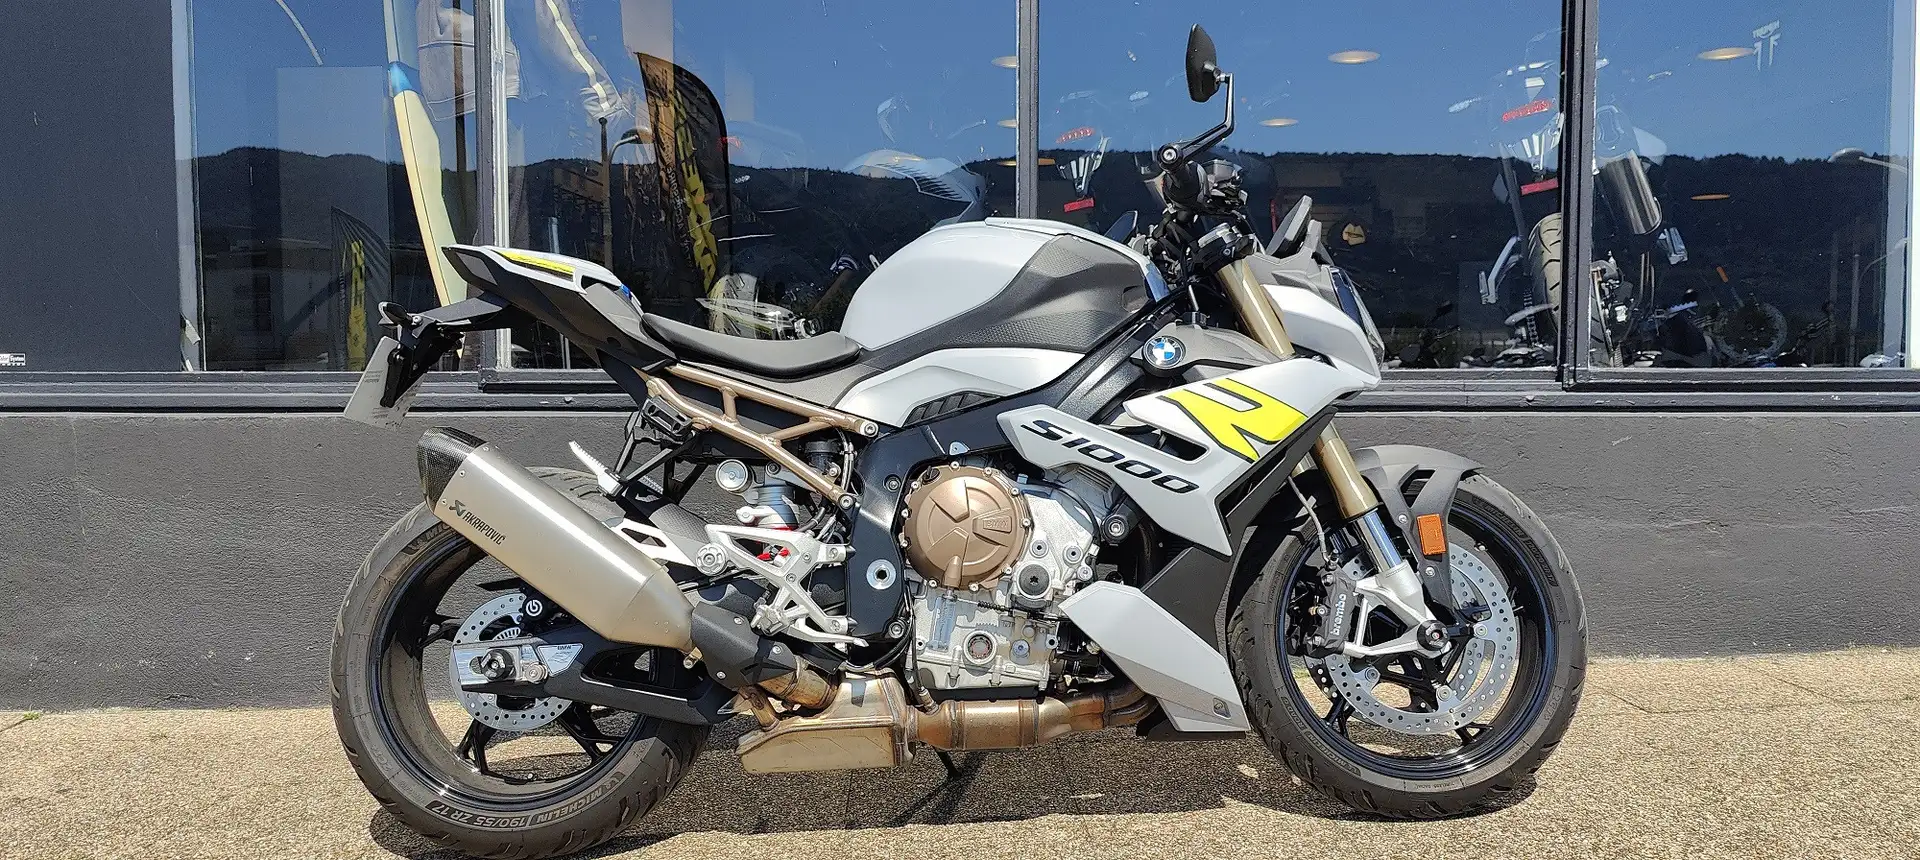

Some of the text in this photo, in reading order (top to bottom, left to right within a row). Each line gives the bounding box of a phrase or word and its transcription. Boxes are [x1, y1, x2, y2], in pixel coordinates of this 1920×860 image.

[1021, 419, 1200, 494] S1000
[1330, 593, 1347, 636] brembo
[433, 788, 603, 828] MICHELIN 190/55 ZR 17
